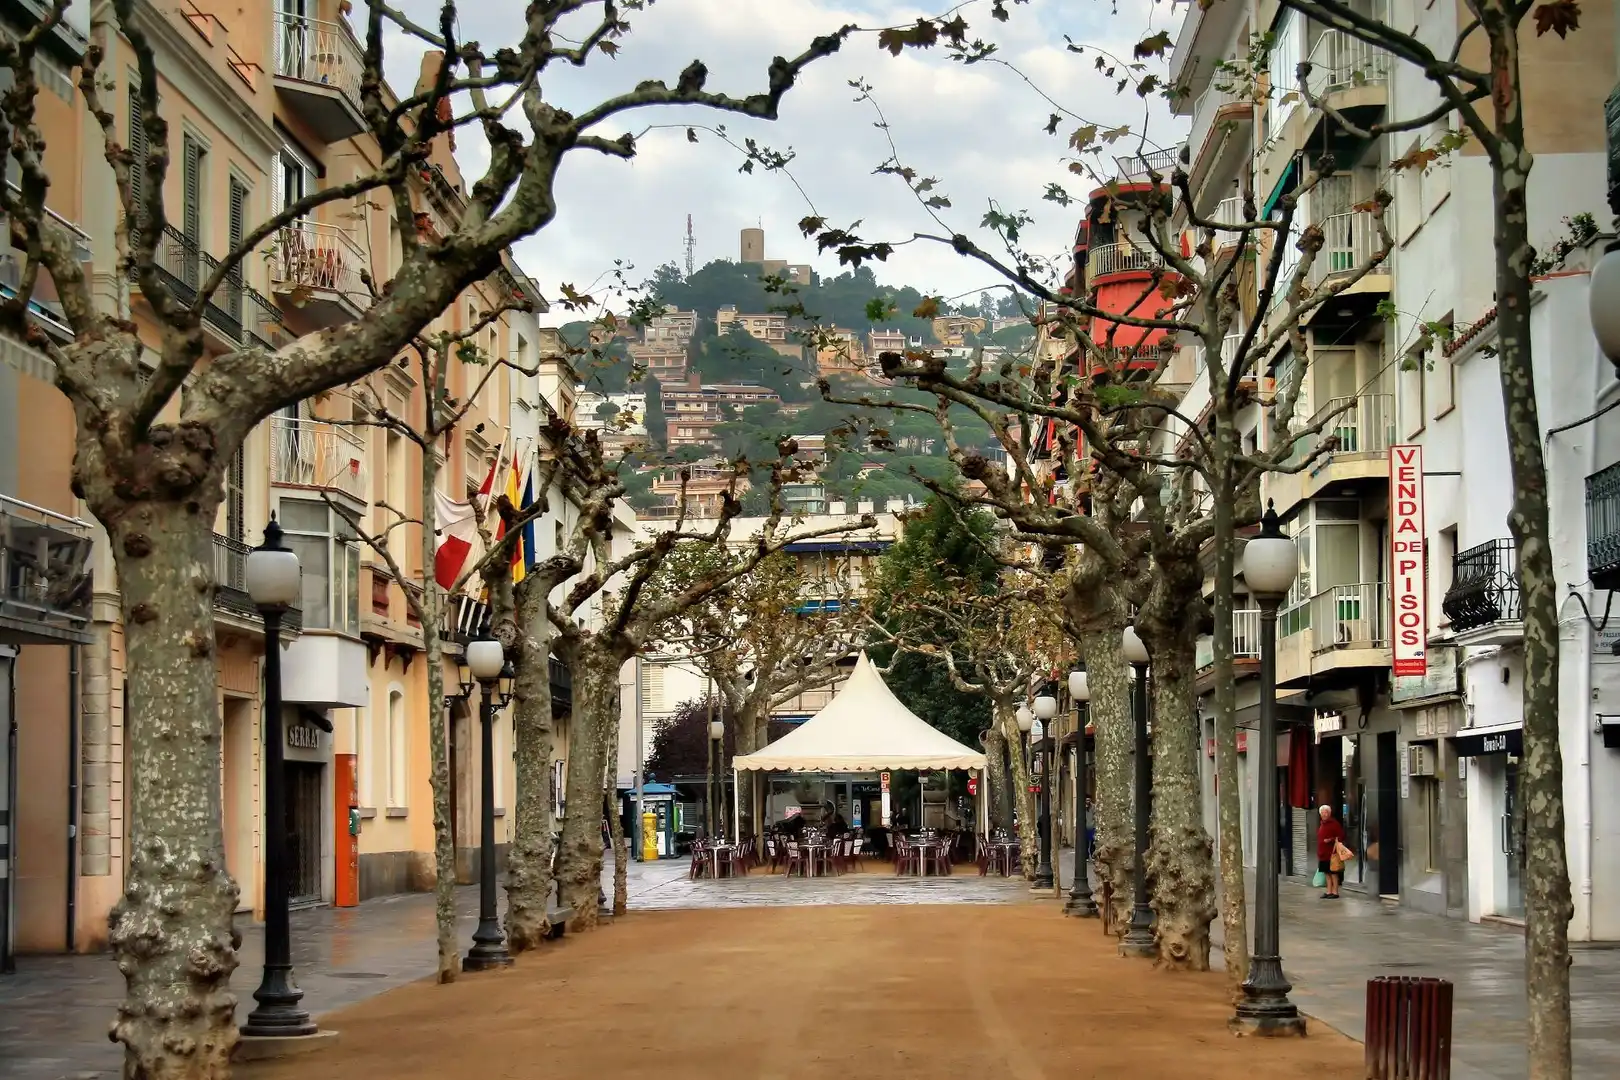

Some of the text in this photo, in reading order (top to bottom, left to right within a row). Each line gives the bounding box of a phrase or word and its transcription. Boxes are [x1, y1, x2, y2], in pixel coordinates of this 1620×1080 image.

[1396, 449, 1418, 534] VENDA
[1394, 541, 1422, 553] DE
[1399, 560, 1420, 646] PISOS
